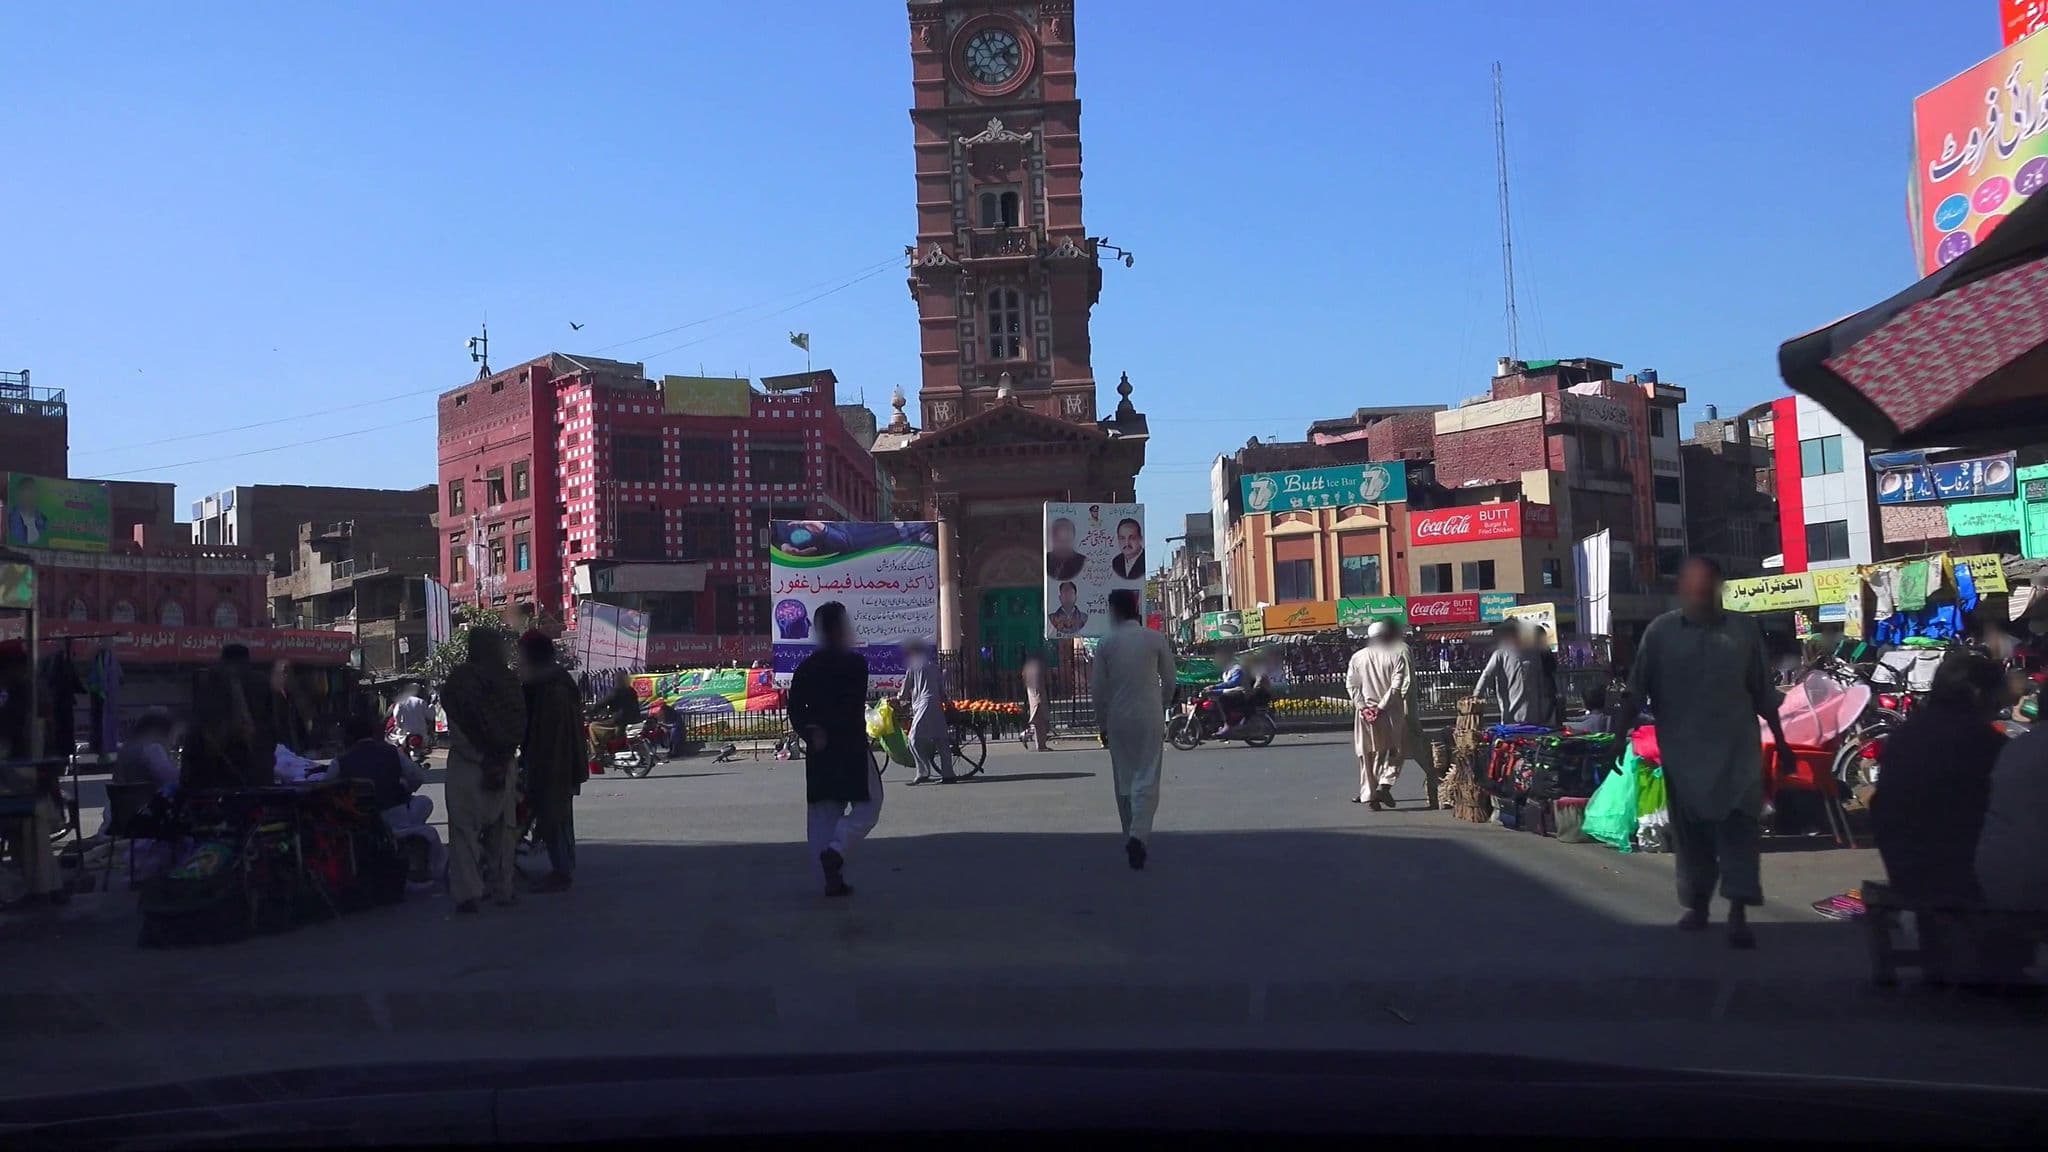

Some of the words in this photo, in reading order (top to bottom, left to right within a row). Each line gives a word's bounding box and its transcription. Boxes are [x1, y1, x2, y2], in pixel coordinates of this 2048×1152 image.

[1283, 474, 1325, 493] Butt
[1327, 479, 1340, 488] Ice
[1341, 477, 1357, 487] Bar
[1479, 508, 1510, 521] BUTT
[1417, 514, 1473, 538] Coca-Cola
[1478, 527, 1493, 535] Fried
[1493, 525, 1514, 535] Chicken
[1484, 521, 1502, 529] Burger
[775, 573, 810, 594] غفور
[810, 573, 851, 594] فیصل
[854, 575, 899, 590] محمد
[900, 574, 935, 594] ڈاکٹر
[1769, 577, 1803, 595] الکوثر
[1733, 585, 1747, 599] بار
[1410, 601, 1451, 617] Coca-Cola
